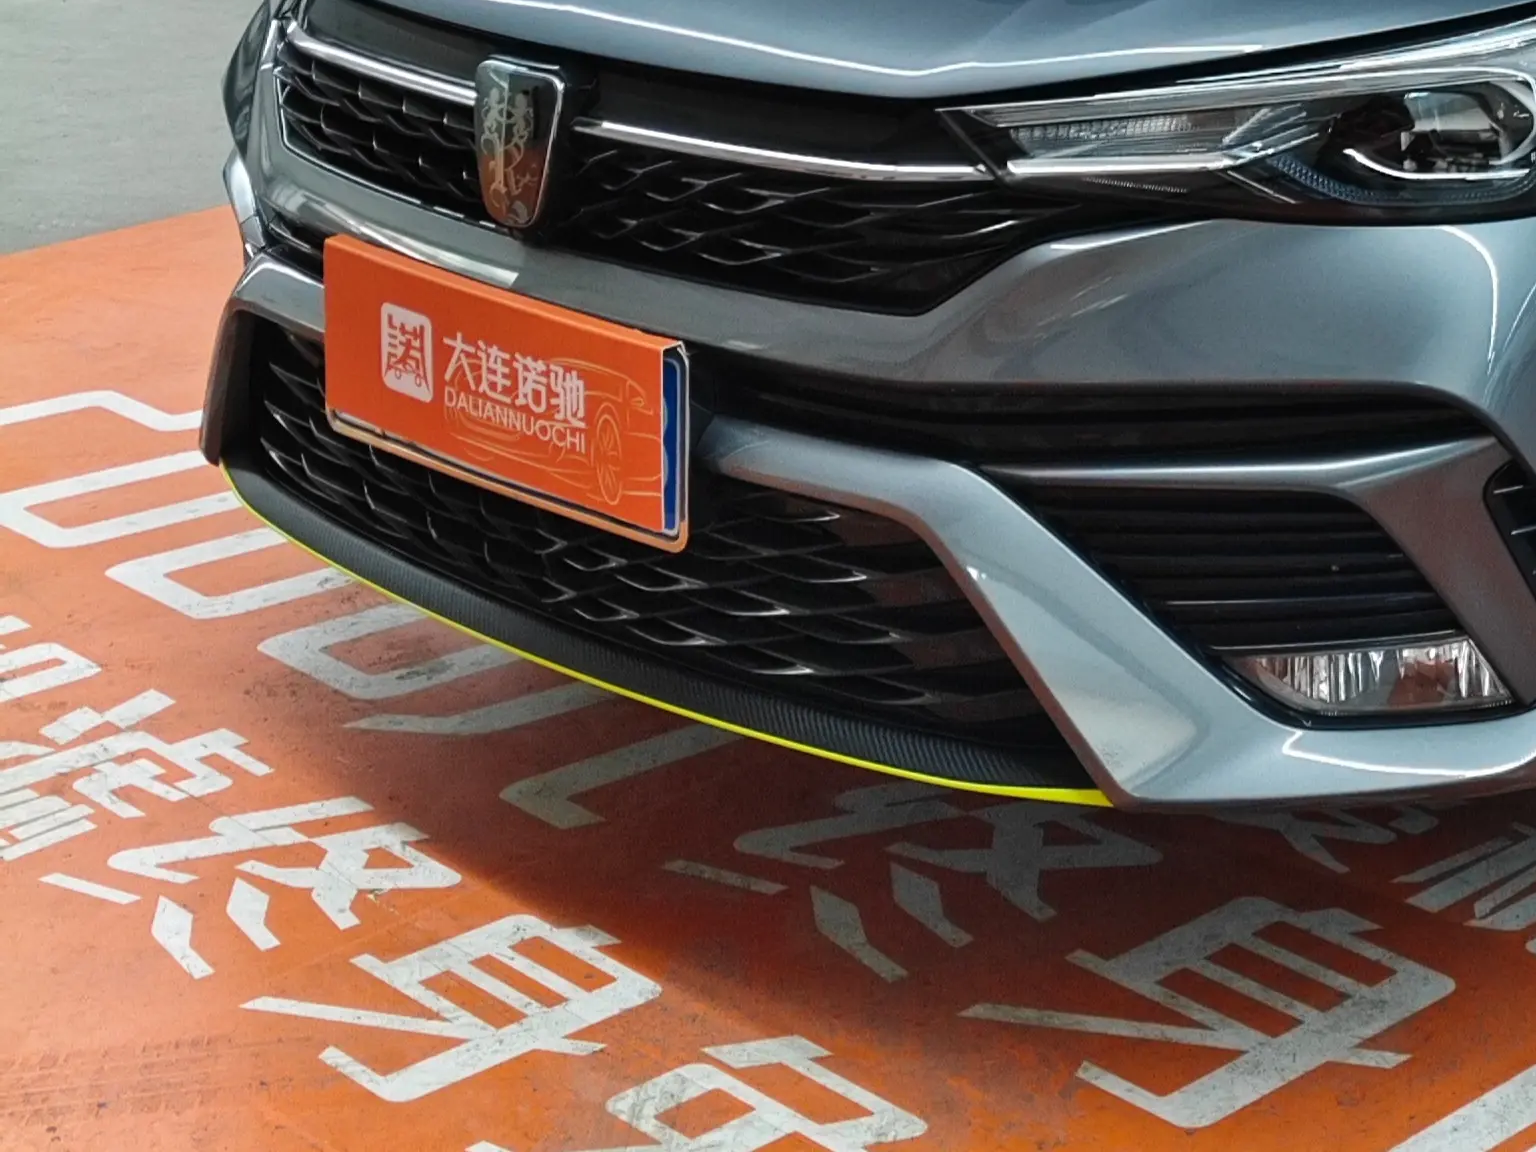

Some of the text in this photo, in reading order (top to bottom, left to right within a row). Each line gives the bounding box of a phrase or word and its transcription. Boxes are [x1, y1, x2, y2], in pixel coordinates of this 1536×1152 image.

[443, 332, 587, 429] 大连诺驰
[443, 386, 587, 454] DALIANNUOCHI
